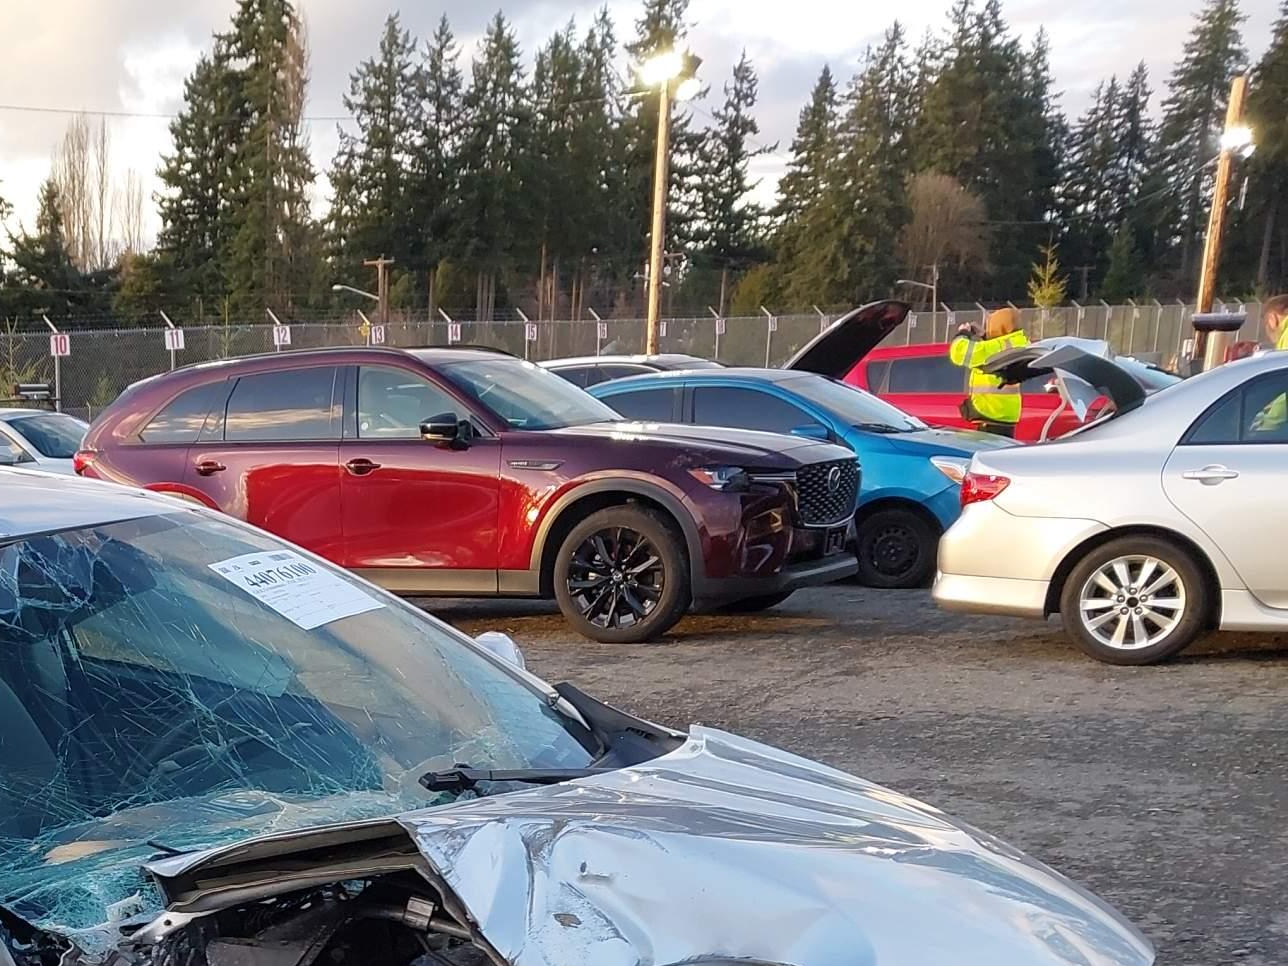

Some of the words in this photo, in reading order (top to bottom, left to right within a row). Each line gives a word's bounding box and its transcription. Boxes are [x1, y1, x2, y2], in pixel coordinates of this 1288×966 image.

[170, 330, 180, 348] 11
[276, 326, 288, 344] 12
[53, 335, 67, 354] 10
[243, 562, 317, 588] 44076100
